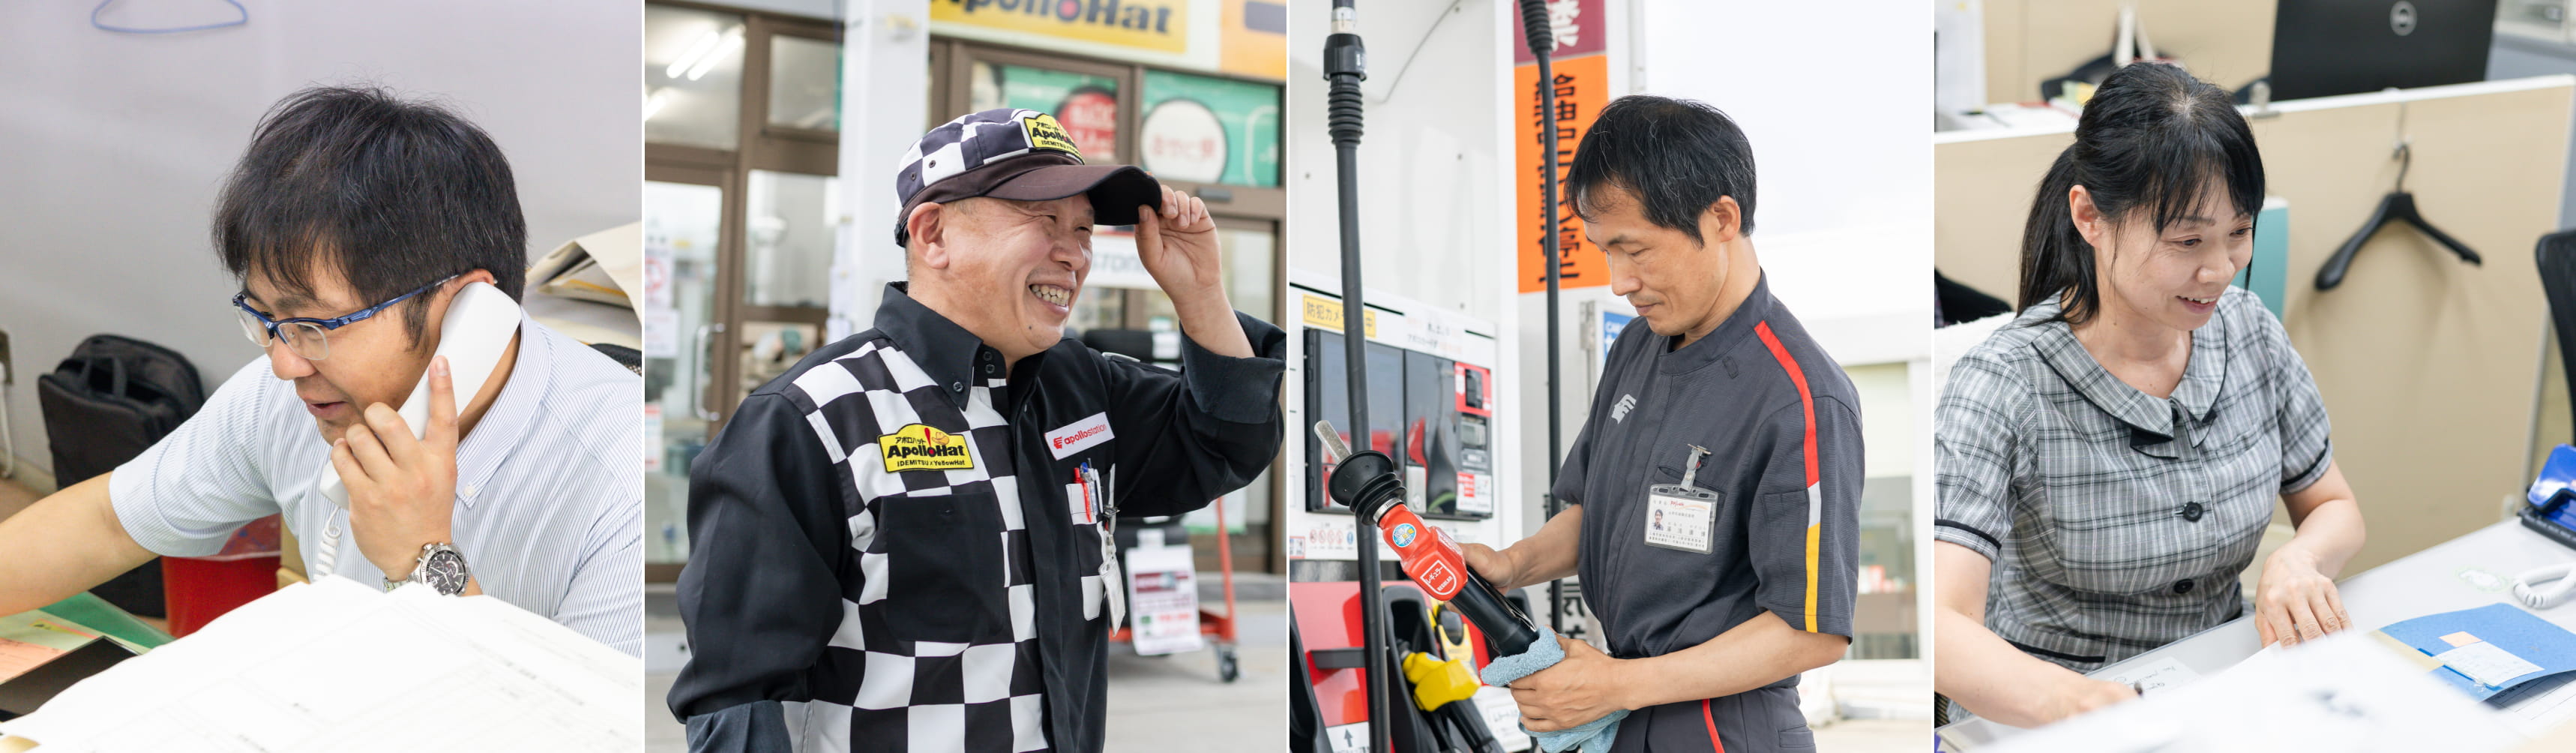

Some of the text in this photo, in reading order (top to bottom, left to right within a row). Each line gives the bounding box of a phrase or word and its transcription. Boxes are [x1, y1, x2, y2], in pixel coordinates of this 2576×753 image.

[895, 436, 927, 445] アポロハット
[1064, 423, 1107, 445] apollostation
[887, 445, 965, 458] ApolloHat
[1424, 566, 1444, 584] レギュラー
